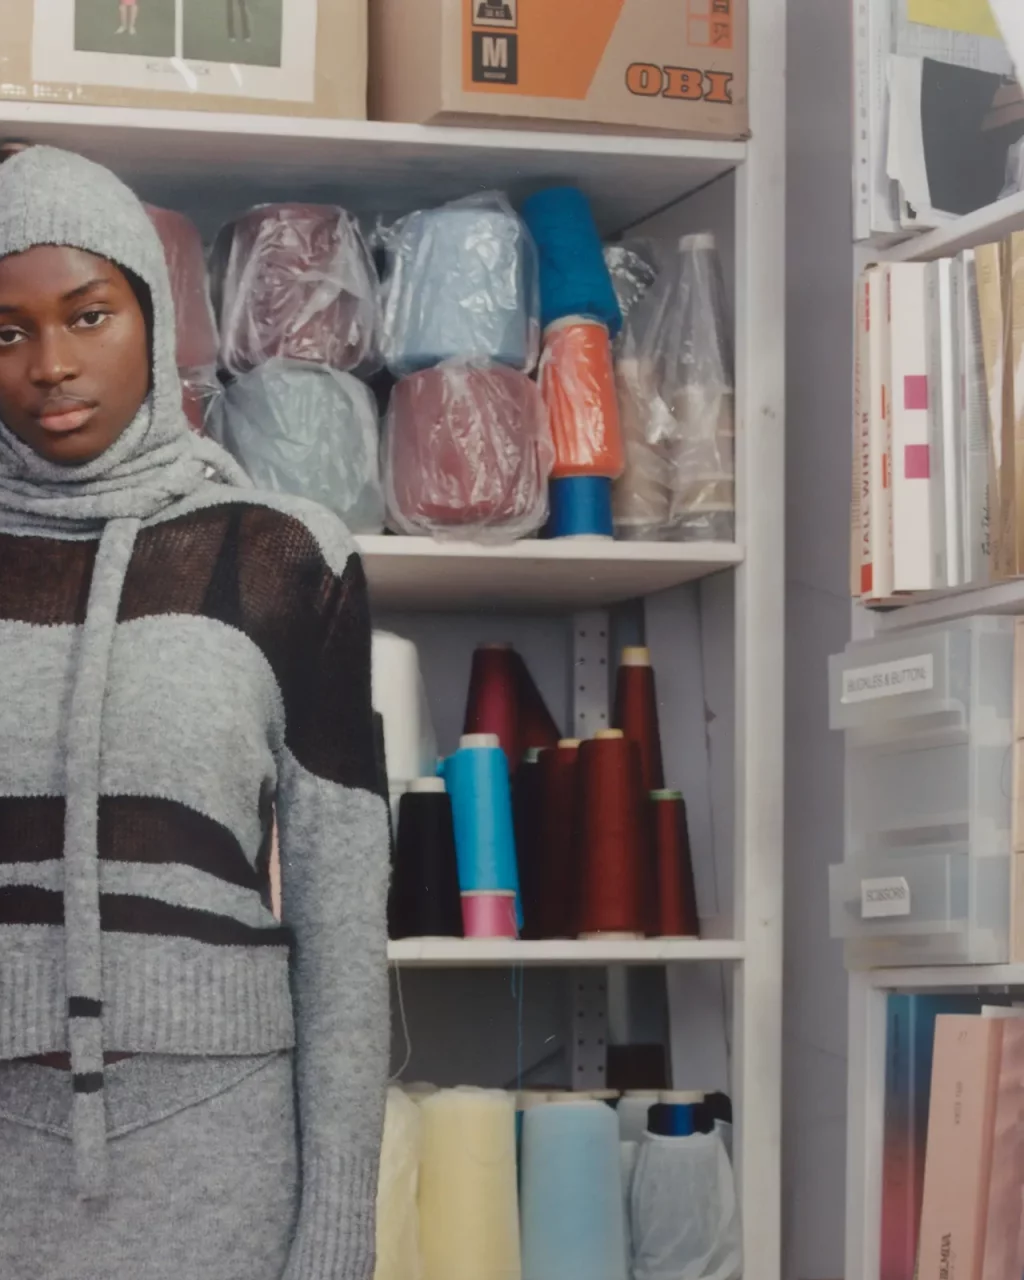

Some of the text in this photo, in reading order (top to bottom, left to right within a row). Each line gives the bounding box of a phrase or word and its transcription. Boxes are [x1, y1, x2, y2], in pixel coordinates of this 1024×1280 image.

[481, 36, 508, 68] M
[625, 62, 733, 104] OBI
[861, 411, 871, 556] FALL WINTER
